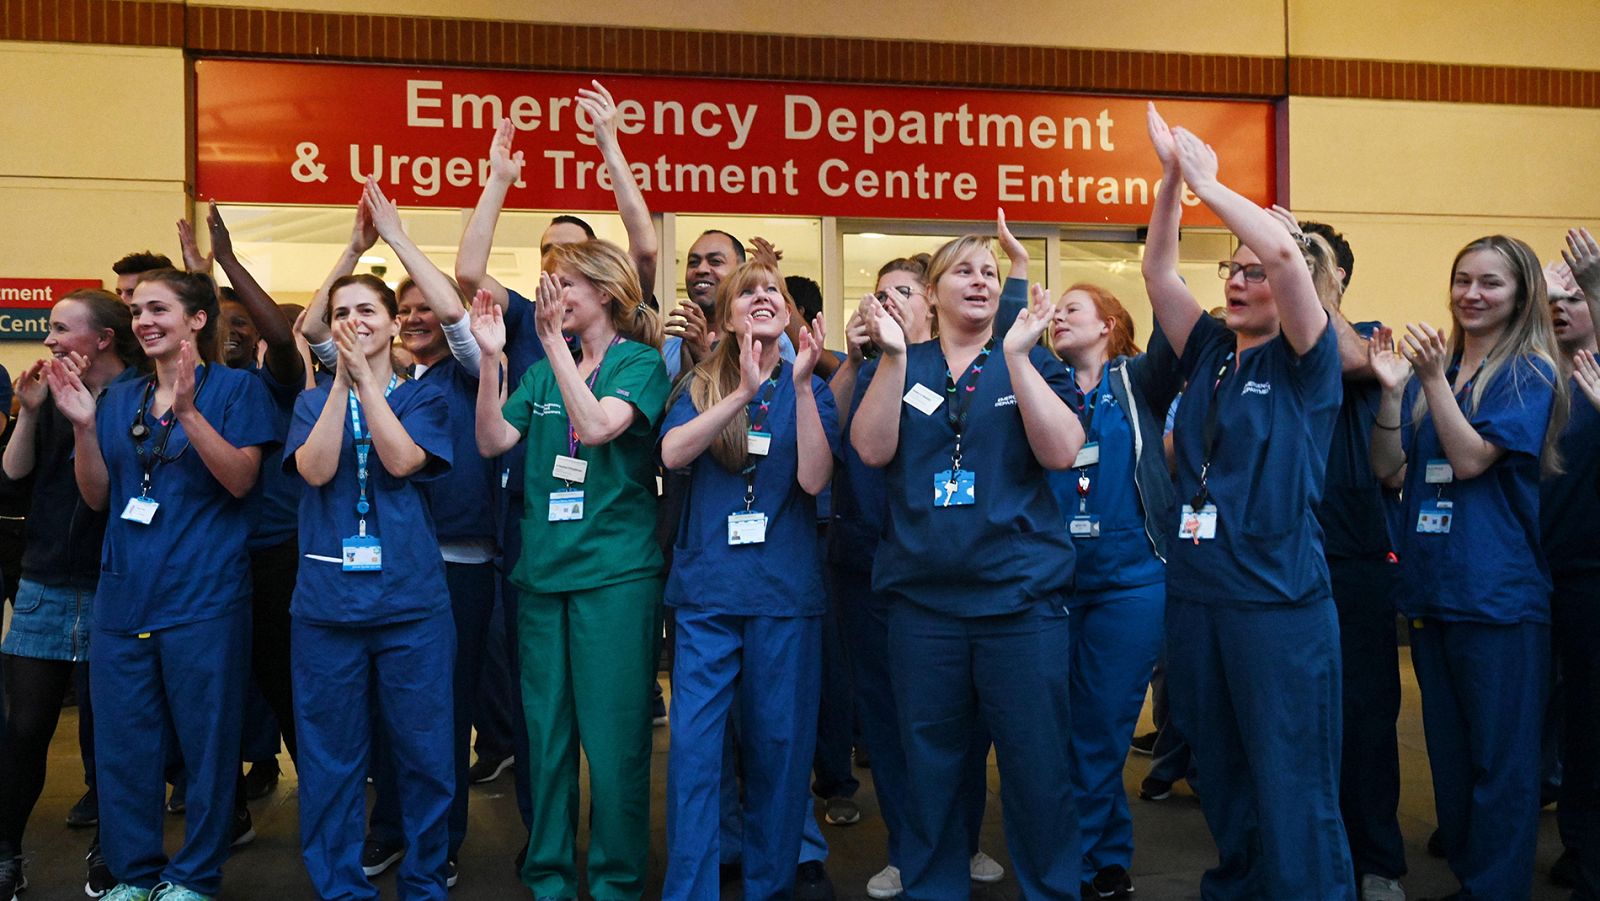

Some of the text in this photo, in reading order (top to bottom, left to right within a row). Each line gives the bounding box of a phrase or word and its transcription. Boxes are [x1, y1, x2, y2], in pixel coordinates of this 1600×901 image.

[783, 94, 1115, 154] Department
[290, 141, 328, 183] &
[818, 157, 978, 201] Centre
[0, 286, 52, 301] ment
[0, 315, 50, 332] Cent
